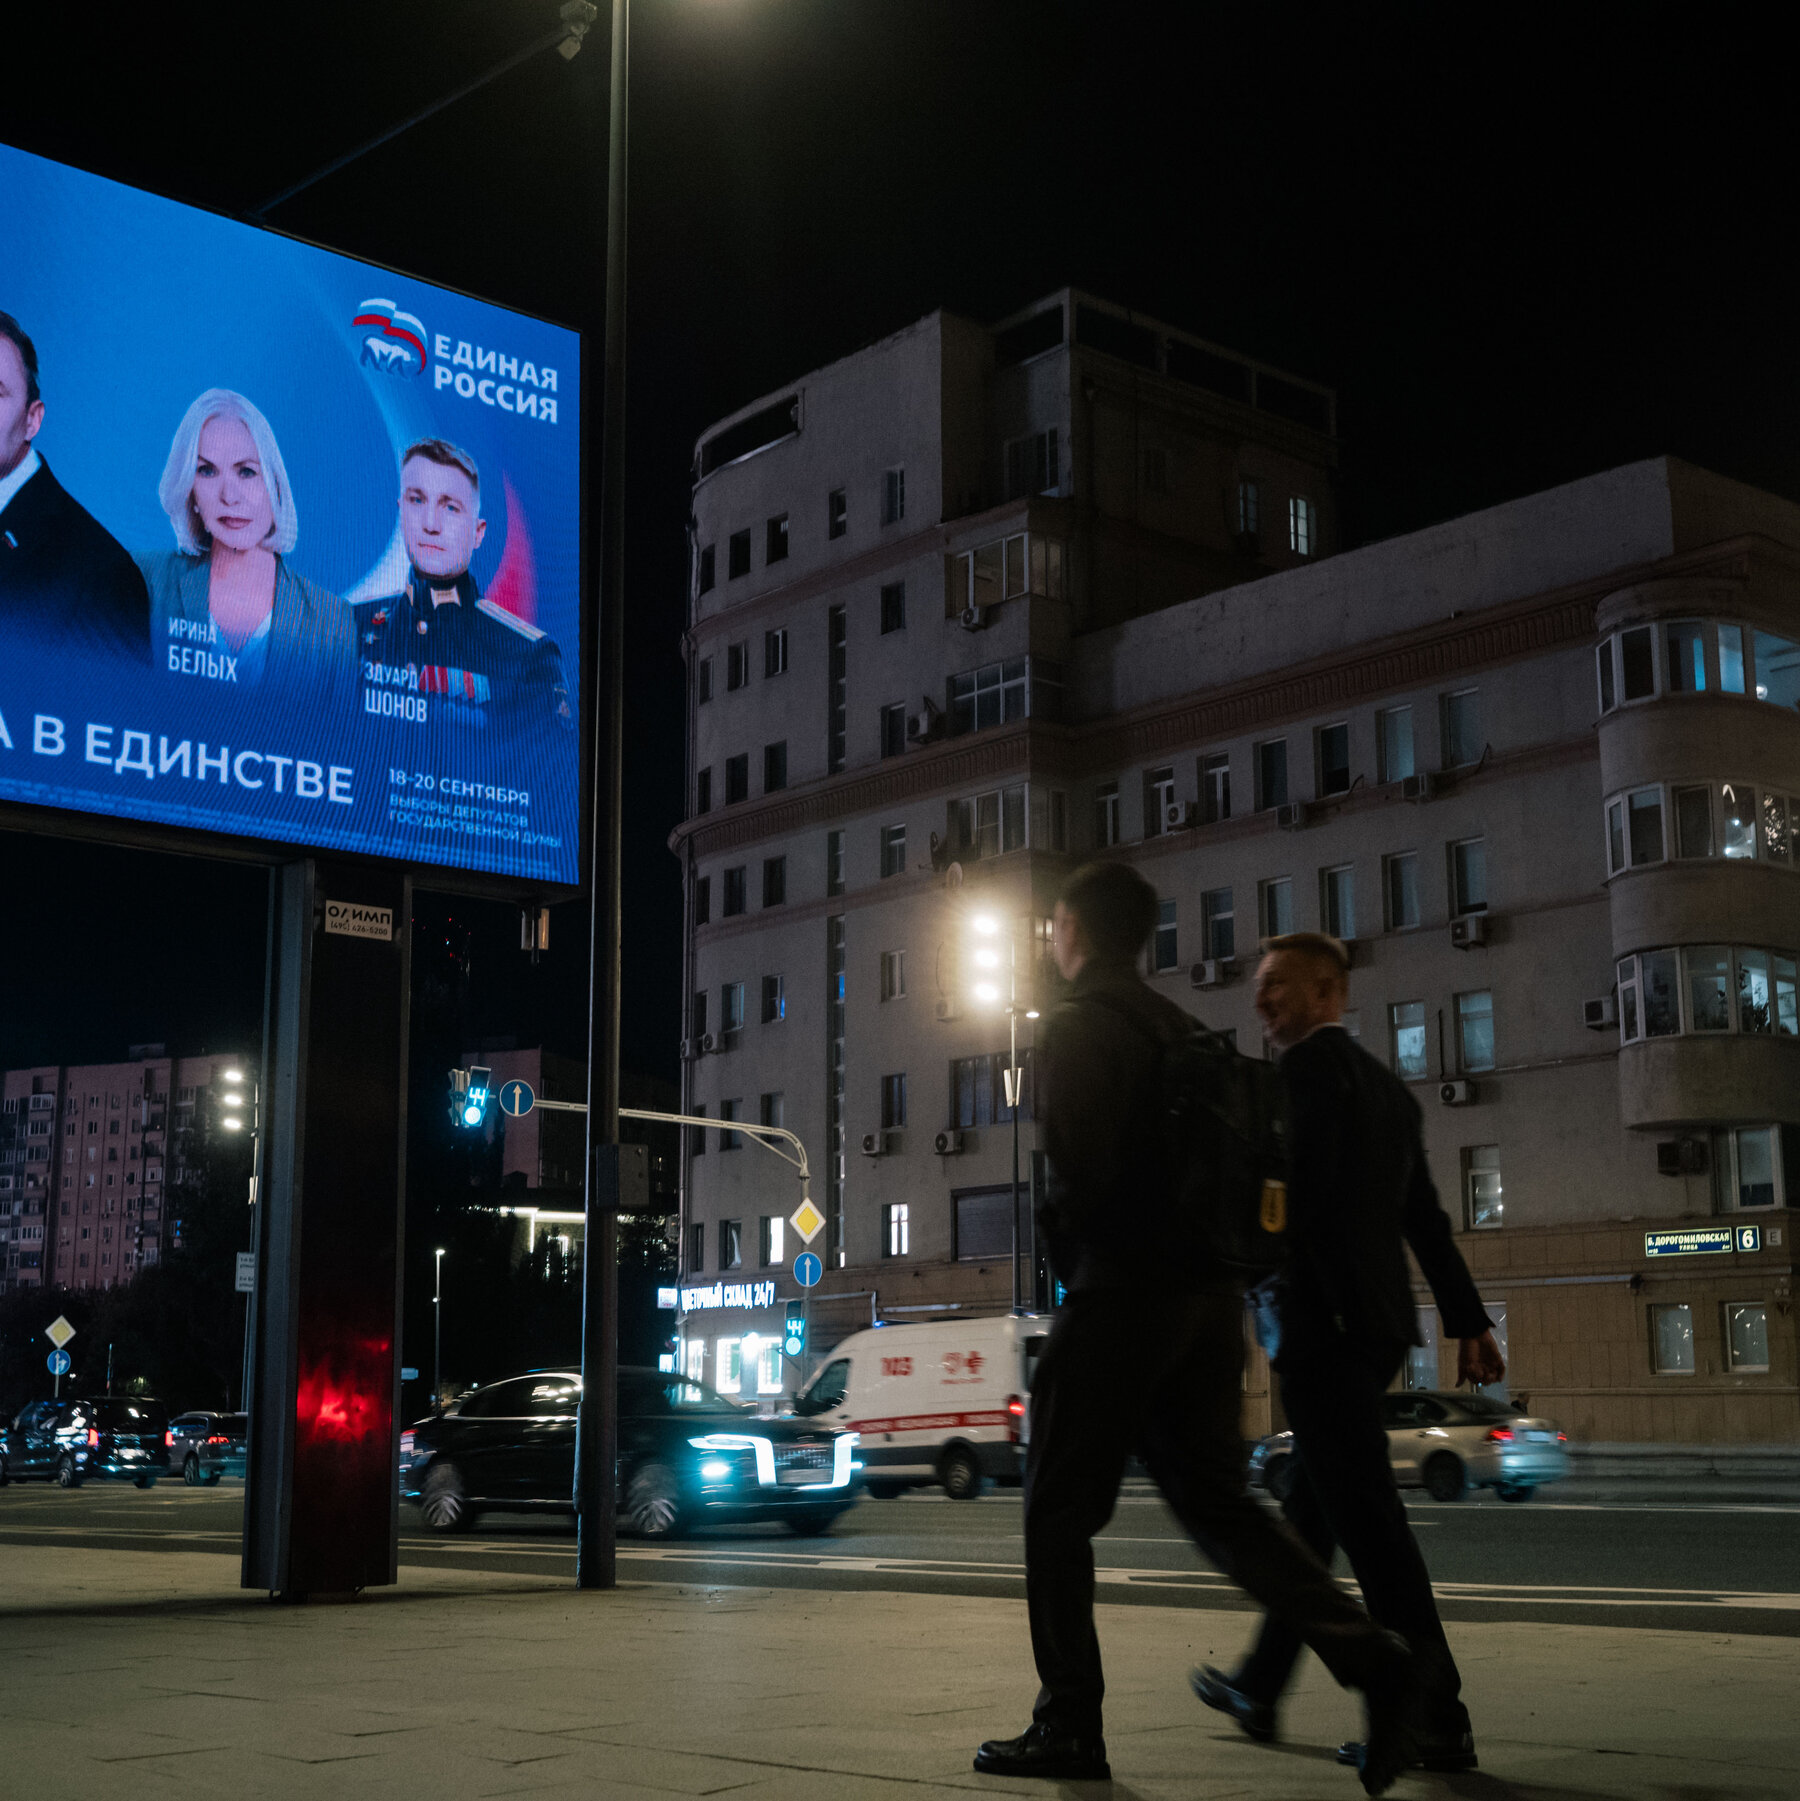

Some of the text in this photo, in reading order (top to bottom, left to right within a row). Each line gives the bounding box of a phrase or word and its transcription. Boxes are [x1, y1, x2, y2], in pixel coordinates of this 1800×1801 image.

[434, 333, 558, 392] ЕДИНАЯ
[434, 364, 558, 424] РОССИЯ
[168, 617, 218, 645] ИРИНА
[168, 645, 238, 683] БЕЛЫХ
[365, 661, 418, 691] ЭДУАРД
[365, 688, 428, 723] ШОНОВ
[33, 713, 66, 756] В
[85, 723, 354, 806] ЕДИНСТВЕ
[439, 778, 529, 806] СЕНТЯБРЯ
[390, 794, 528, 827] ВЫБОРЫ ДЕПУТАТОВ
[390, 810, 520, 842] ГОСУДАРСТВЕННОЙ
[522, 831, 561, 848] ДУМЫ
[469, 1087, 487, 1106] 44
[1655, 1232, 1730, 1247] ДОРОГОМИЛОВСКАЯ
[1679, 1244, 1698, 1252] УЛИЦА
[1742, 1230, 1754, 1248] 6
[681, 1280, 776, 1314] ЦВЕТОЧНЫЙ СКЛАД 24/7
[787, 1320, 802, 1336] 44
